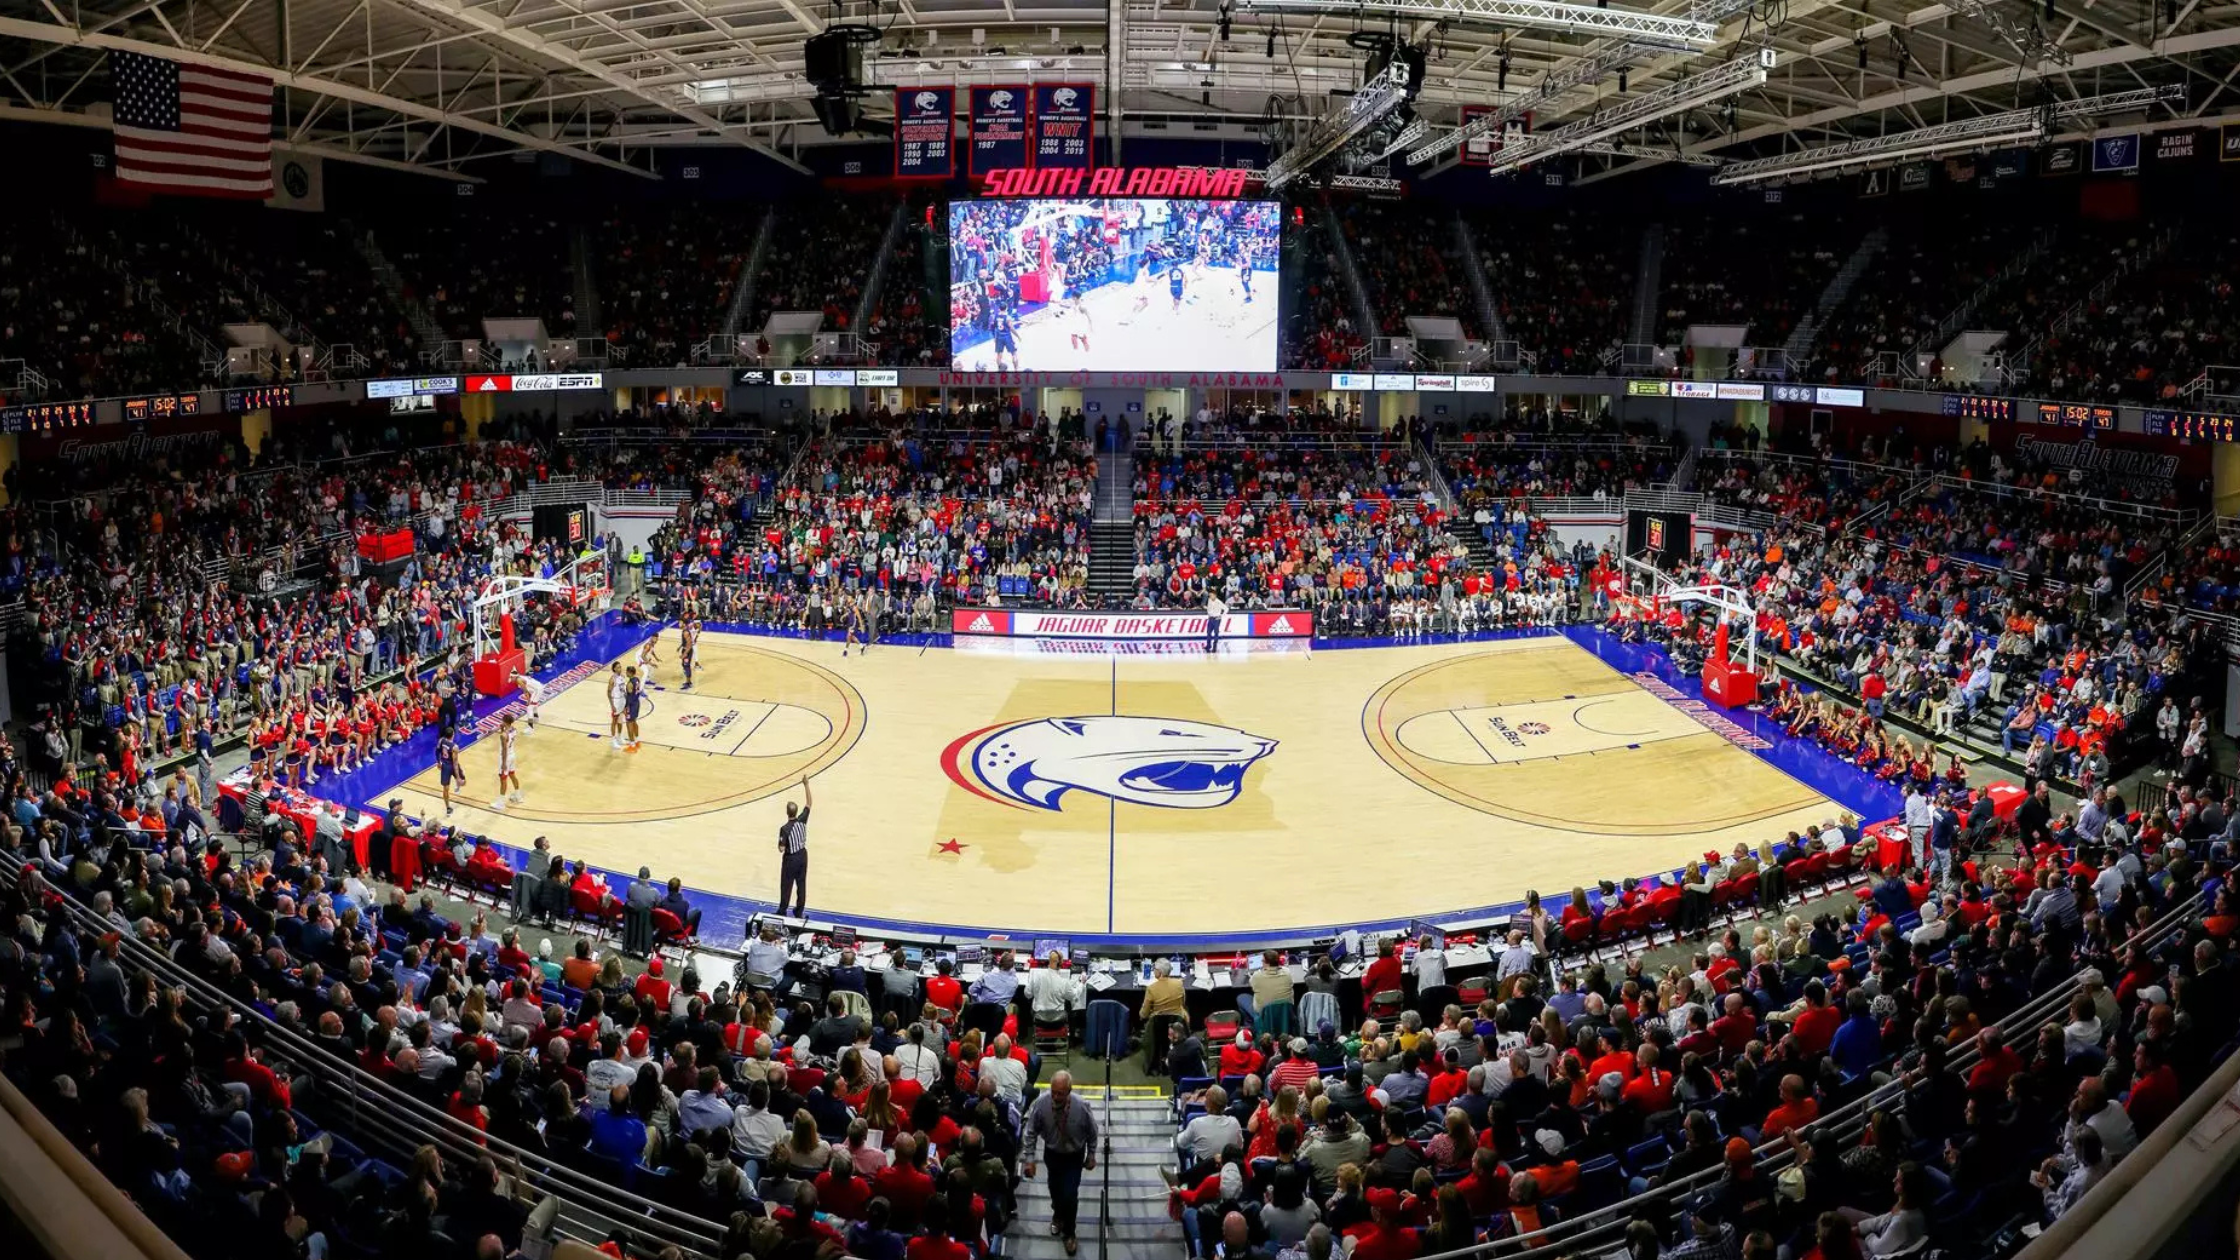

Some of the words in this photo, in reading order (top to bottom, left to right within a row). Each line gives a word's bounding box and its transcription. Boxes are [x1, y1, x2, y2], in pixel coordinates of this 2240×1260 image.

[1044, 122, 1082, 137] WNIT
[2157, 145, 2194, 159] CAJUNS
[981, 168, 1085, 196] SOUTH
[1088, 166, 1247, 198] ALABAMA
[941, 373, 1053, 386] UNIVERSITY
[1070, 373, 1092, 386] OF
[1112, 373, 1173, 386] SOUTH
[1188, 373, 1285, 387] ALABAMA
[2045, 413, 2056, 422] 41
[2066, 406, 2089, 420] 15:02
[2099, 417, 2110, 427] 47
[1034, 617, 1109, 634] JAGUAR
[1116, 616, 1232, 633] BASKETBL
[701, 722, 724, 739] SUN
[1488, 717, 1510, 731] SUN
[1502, 730, 1526, 747] BELT
[1500, 1040, 1518, 1052] WAR
